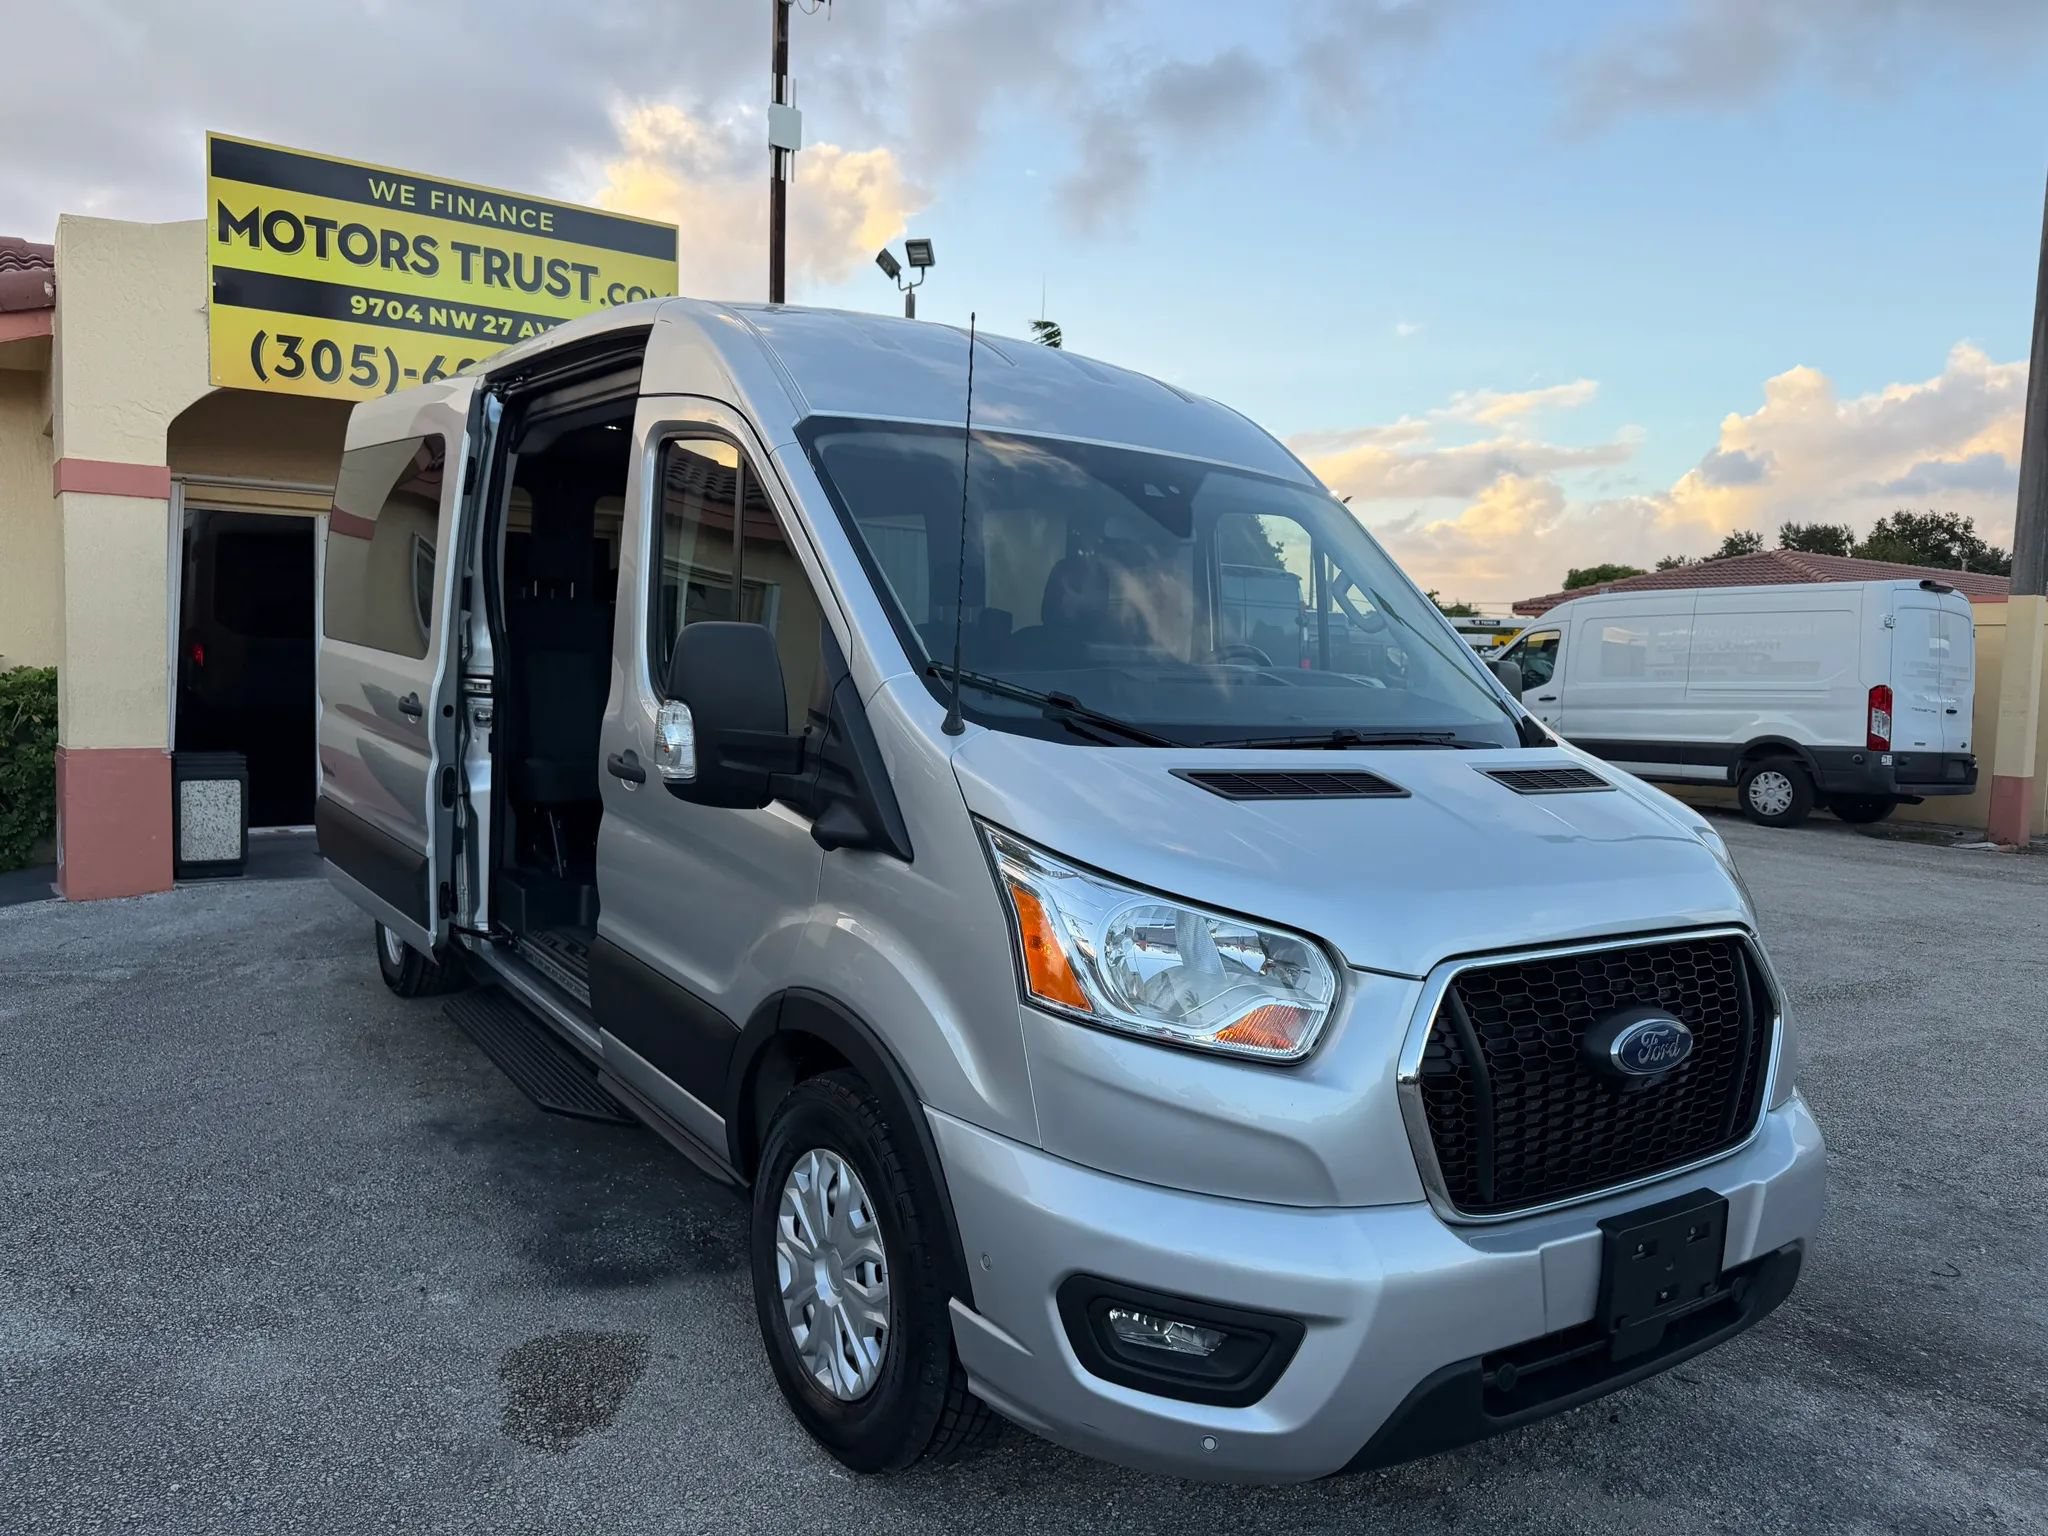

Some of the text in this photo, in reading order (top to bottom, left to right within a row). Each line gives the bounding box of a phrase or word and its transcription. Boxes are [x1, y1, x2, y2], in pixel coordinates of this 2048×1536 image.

[368, 178, 554, 232] WE FINANCE
[217, 199, 440, 278] MOTORS
[350, 295, 423, 323] 9704
[429, 306, 477, 331] NW
[482, 314, 513, 336] 27
[1637, 1029, 1681, 1064] Ford
